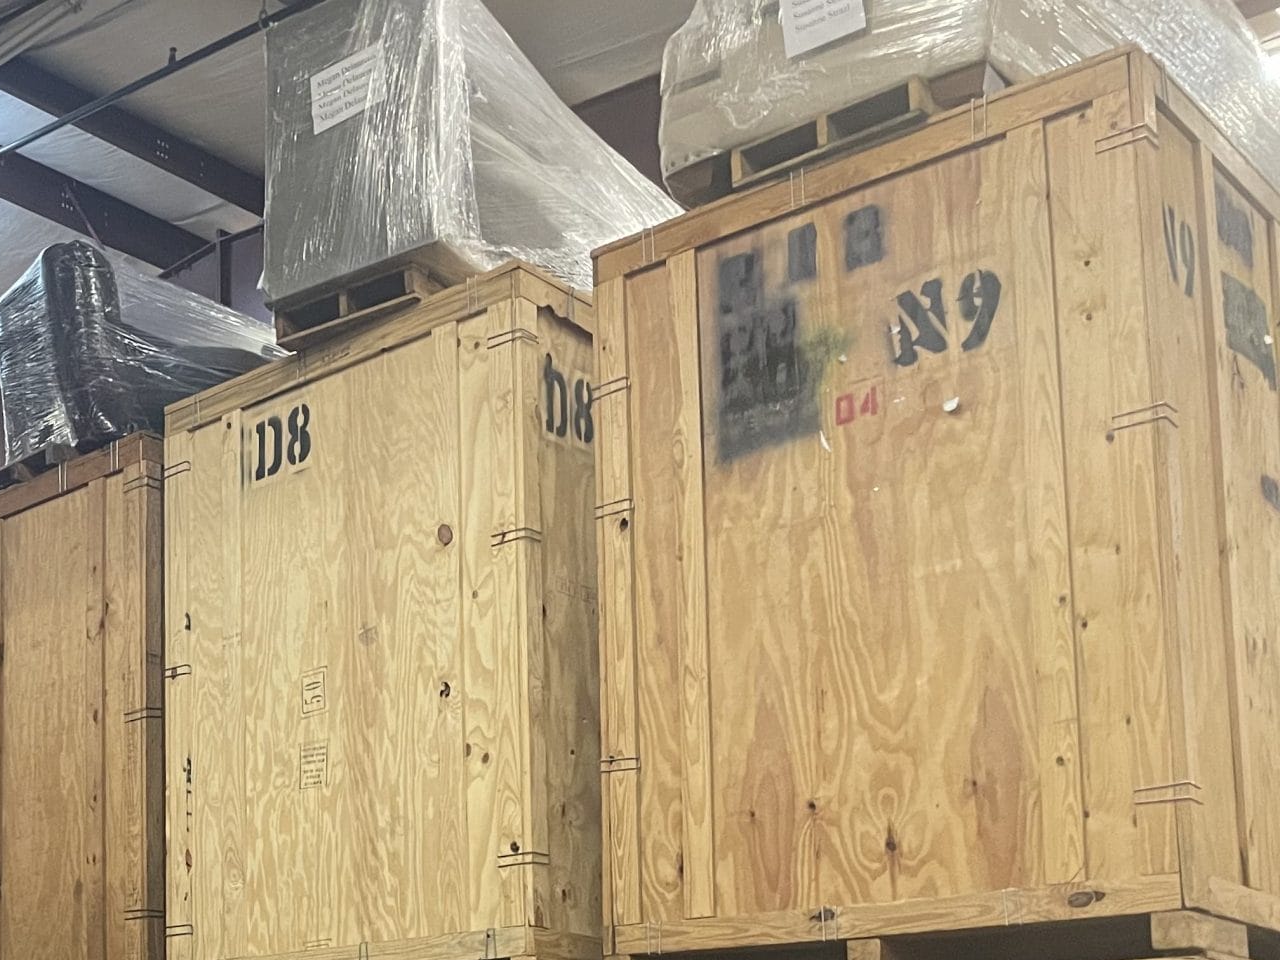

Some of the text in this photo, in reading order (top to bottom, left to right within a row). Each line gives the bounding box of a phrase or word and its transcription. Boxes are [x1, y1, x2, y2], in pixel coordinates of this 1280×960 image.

[888, 269, 1001, 366] N9
[256, 403, 311, 481] D8
[544, 352, 593, 443] D8
